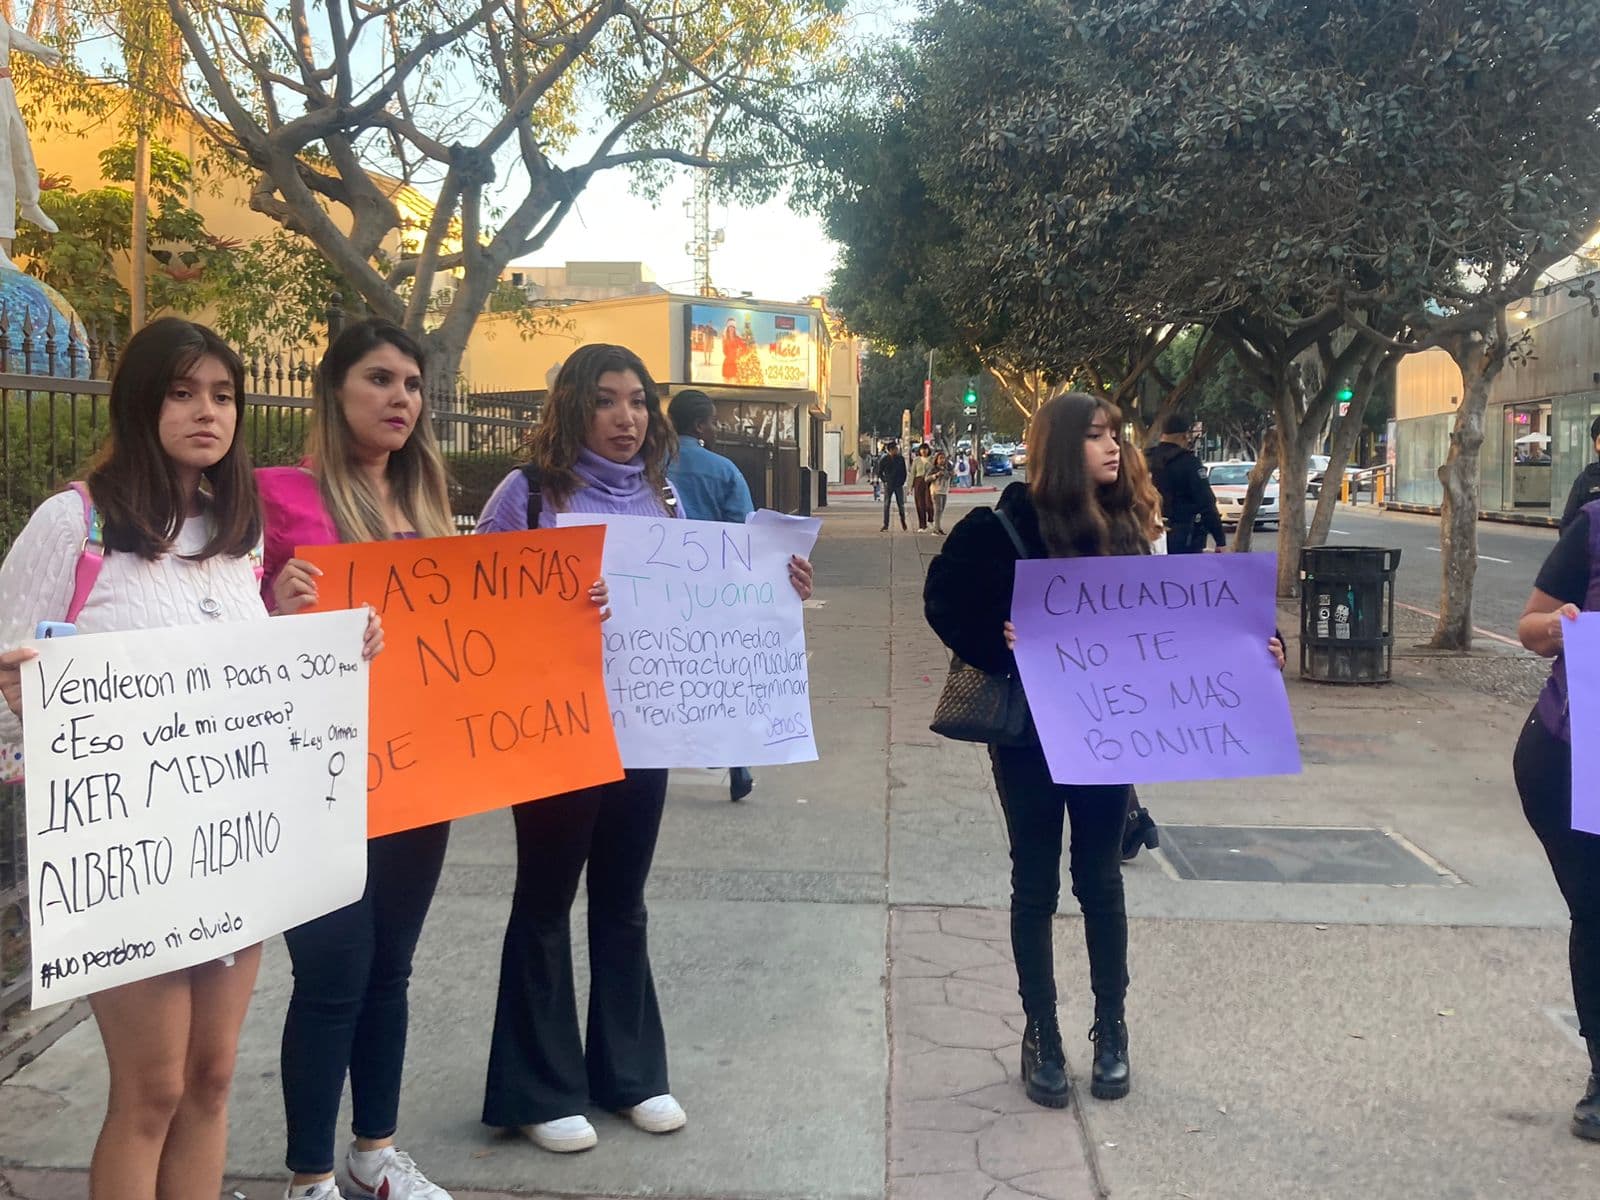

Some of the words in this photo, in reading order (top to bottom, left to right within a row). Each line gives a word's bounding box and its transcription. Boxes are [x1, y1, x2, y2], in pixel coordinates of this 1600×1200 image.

[473, 546, 581, 601] NIÑAS
[608, 572, 775, 621] Tijuana
[1044, 574, 1240, 616] CALLADITA
[416, 618, 497, 687] NO
[1055, 637, 1109, 672] NO
[1128, 630, 1179, 662] TE
[38, 658, 175, 710] Vendieron
[186, 662, 212, 694] mi
[277, 664, 291, 682] a
[296, 653, 336, 680] 300
[611, 676, 675, 704] tiene
[1076, 681, 1148, 723] VES
[1169, 671, 1242, 710] MAS
[142, 711, 191, 746] vale
[195, 715, 217, 735] mi
[456, 691, 591, 759] TOCAN
[1083, 722, 1250, 762] BONITA
[38, 772, 129, 836] IKER
[146, 740, 269, 809] MEDINA
[39, 836, 173, 926] ALBERTO
[190, 810, 281, 879] ALBINO
[164, 927, 183, 949] ni
